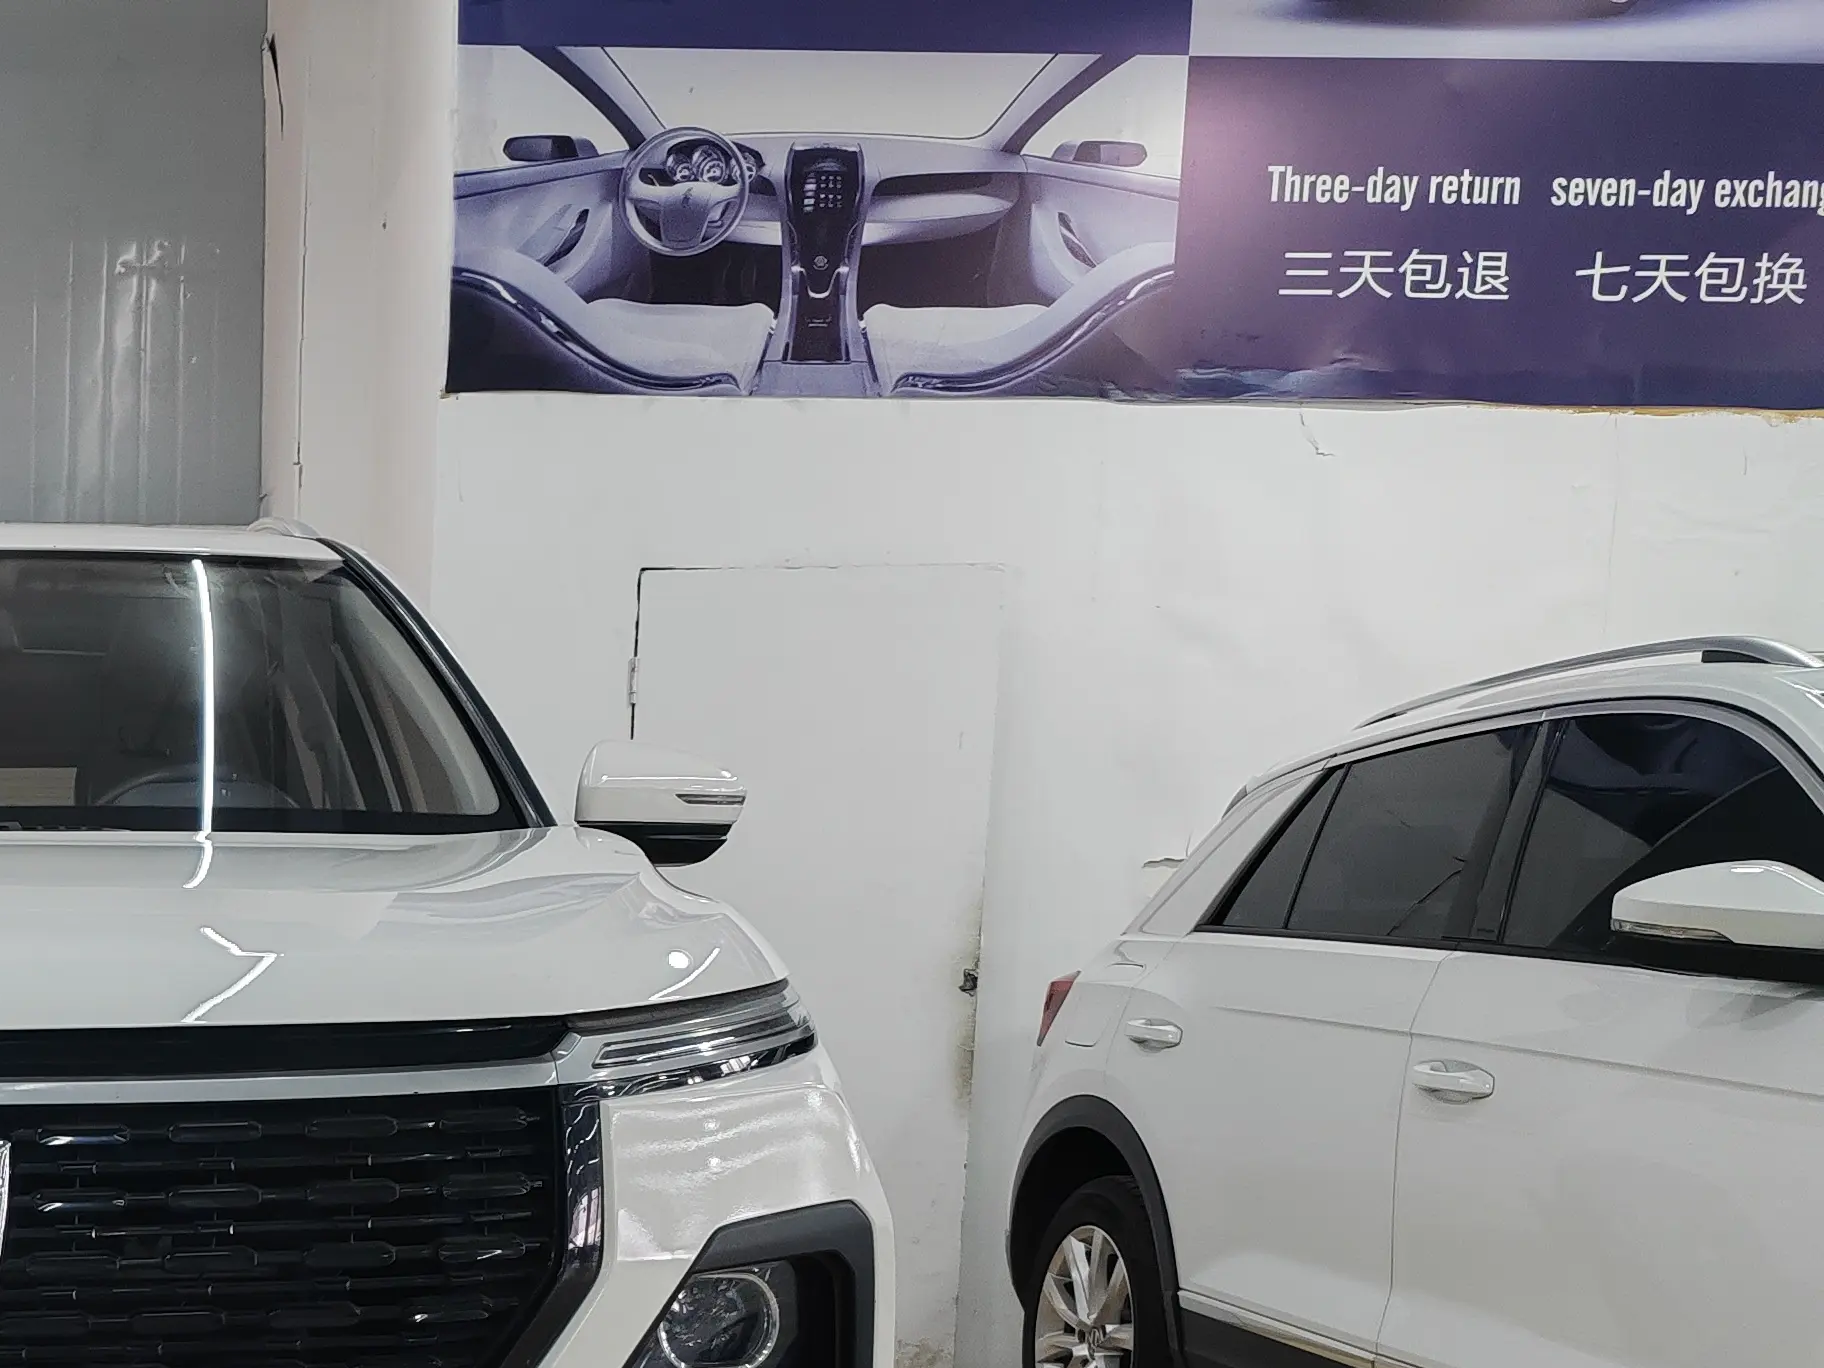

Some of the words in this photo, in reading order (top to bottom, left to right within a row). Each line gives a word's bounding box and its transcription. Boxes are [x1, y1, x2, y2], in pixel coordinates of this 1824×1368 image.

[1267, 165, 1419, 212] Three-day
[1428, 168, 1521, 205] return
[1550, 170, 1706, 214] seven-day
[1278, 248, 1510, 300] 三天包退
[1575, 251, 1808, 304] 七天包换
